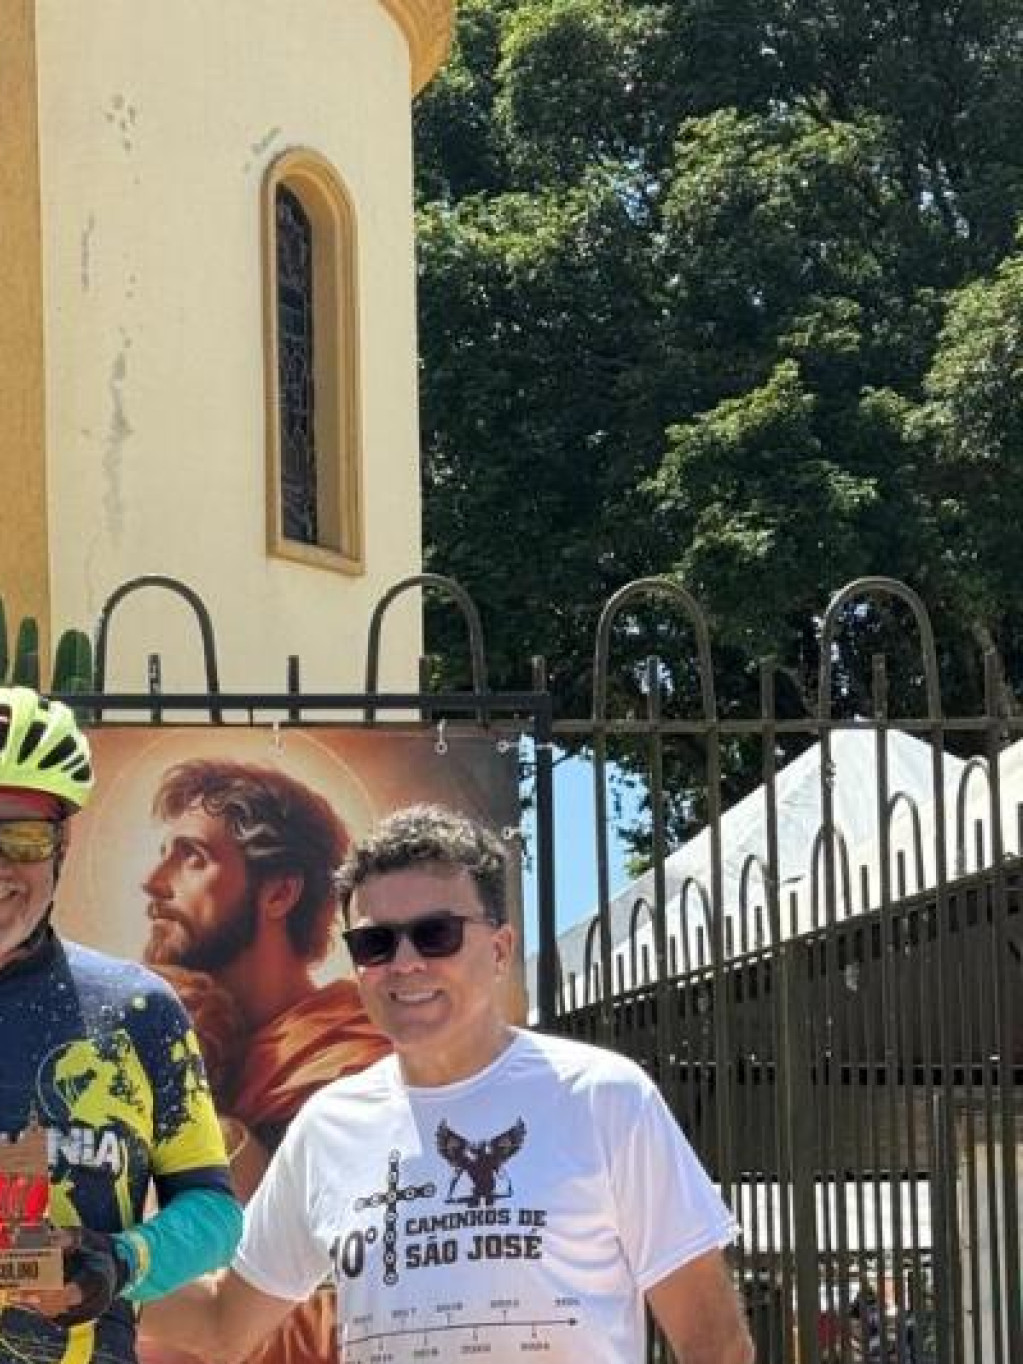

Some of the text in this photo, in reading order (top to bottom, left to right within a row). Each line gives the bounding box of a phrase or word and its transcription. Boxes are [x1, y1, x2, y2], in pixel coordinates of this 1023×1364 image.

[406, 1208, 547, 1236] CAMINHOS DE
[406, 1227, 542, 1269] SÃO JOSÉ
